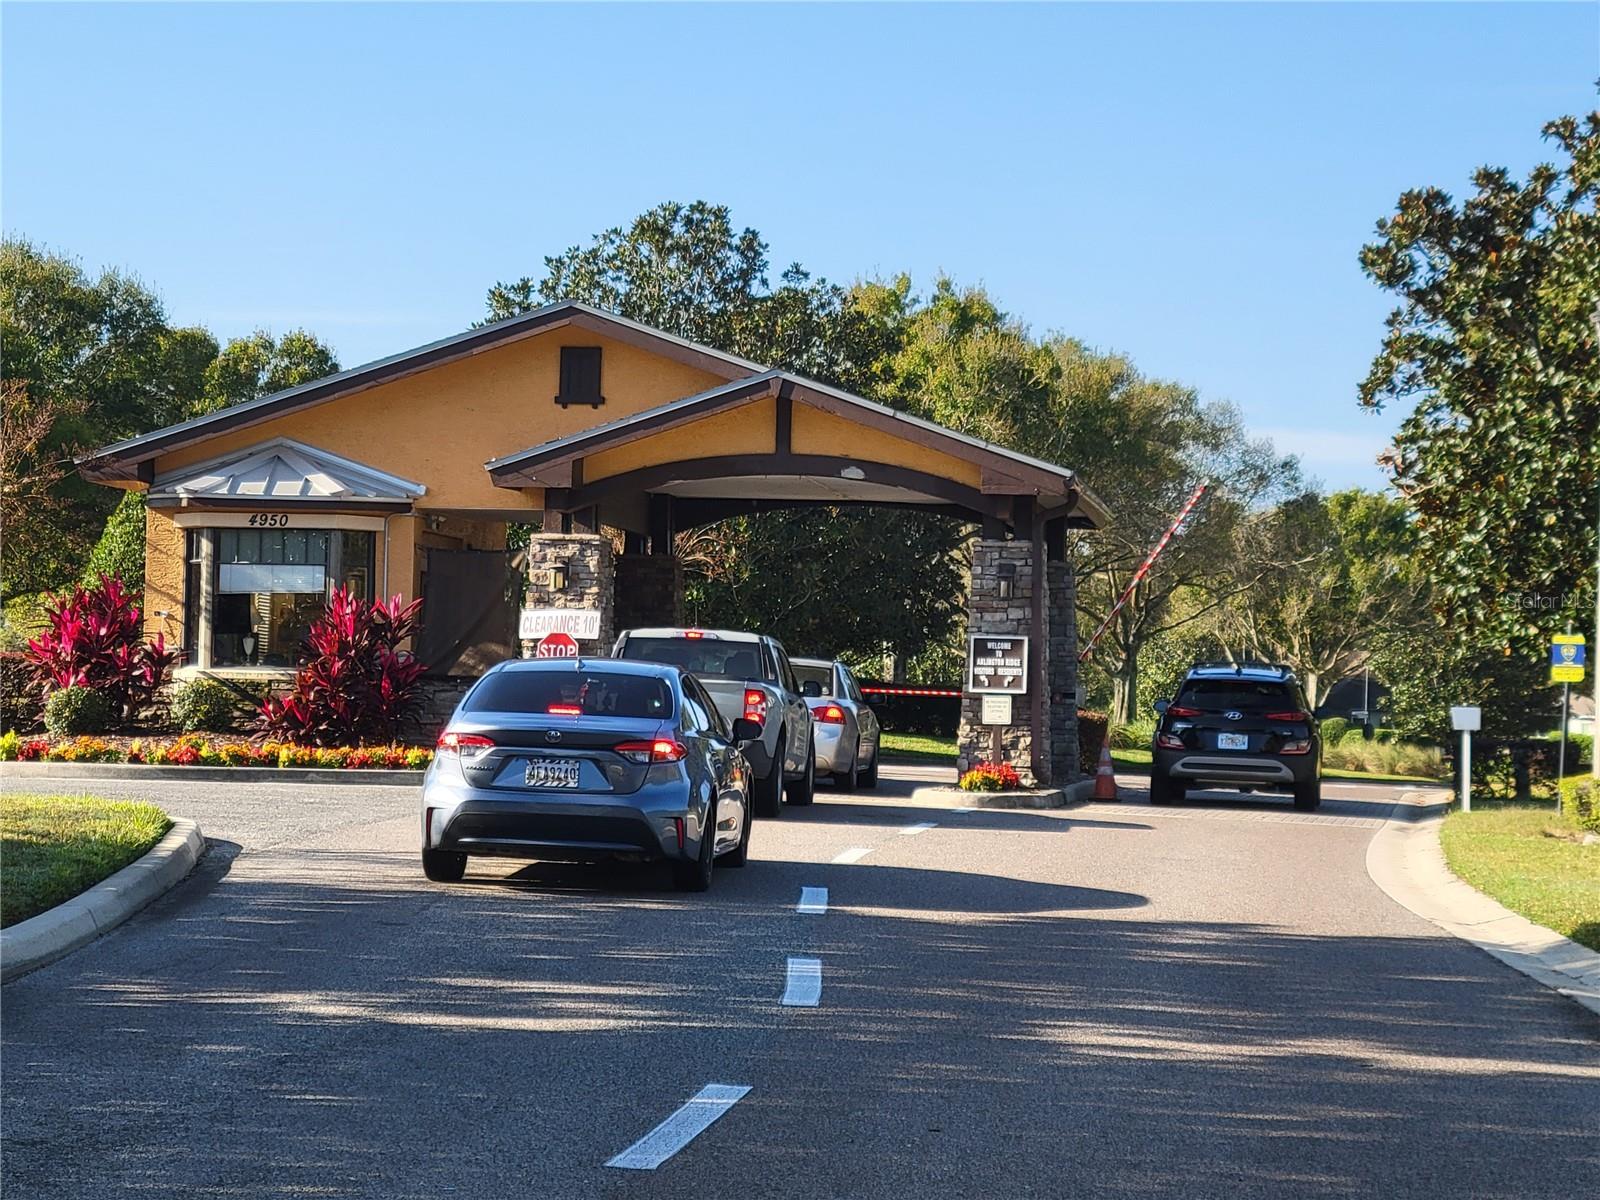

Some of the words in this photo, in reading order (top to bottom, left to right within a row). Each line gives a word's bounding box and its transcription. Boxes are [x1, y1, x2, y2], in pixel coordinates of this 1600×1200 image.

[248, 513, 289, 527] 4950
[523, 615, 580, 633] CLEARANCE
[583, 615, 598, 634] 10'
[539, 644, 576, 657] STOP
[987, 642, 1012, 650] WELCOME
[995, 650, 1003, 658] TO
